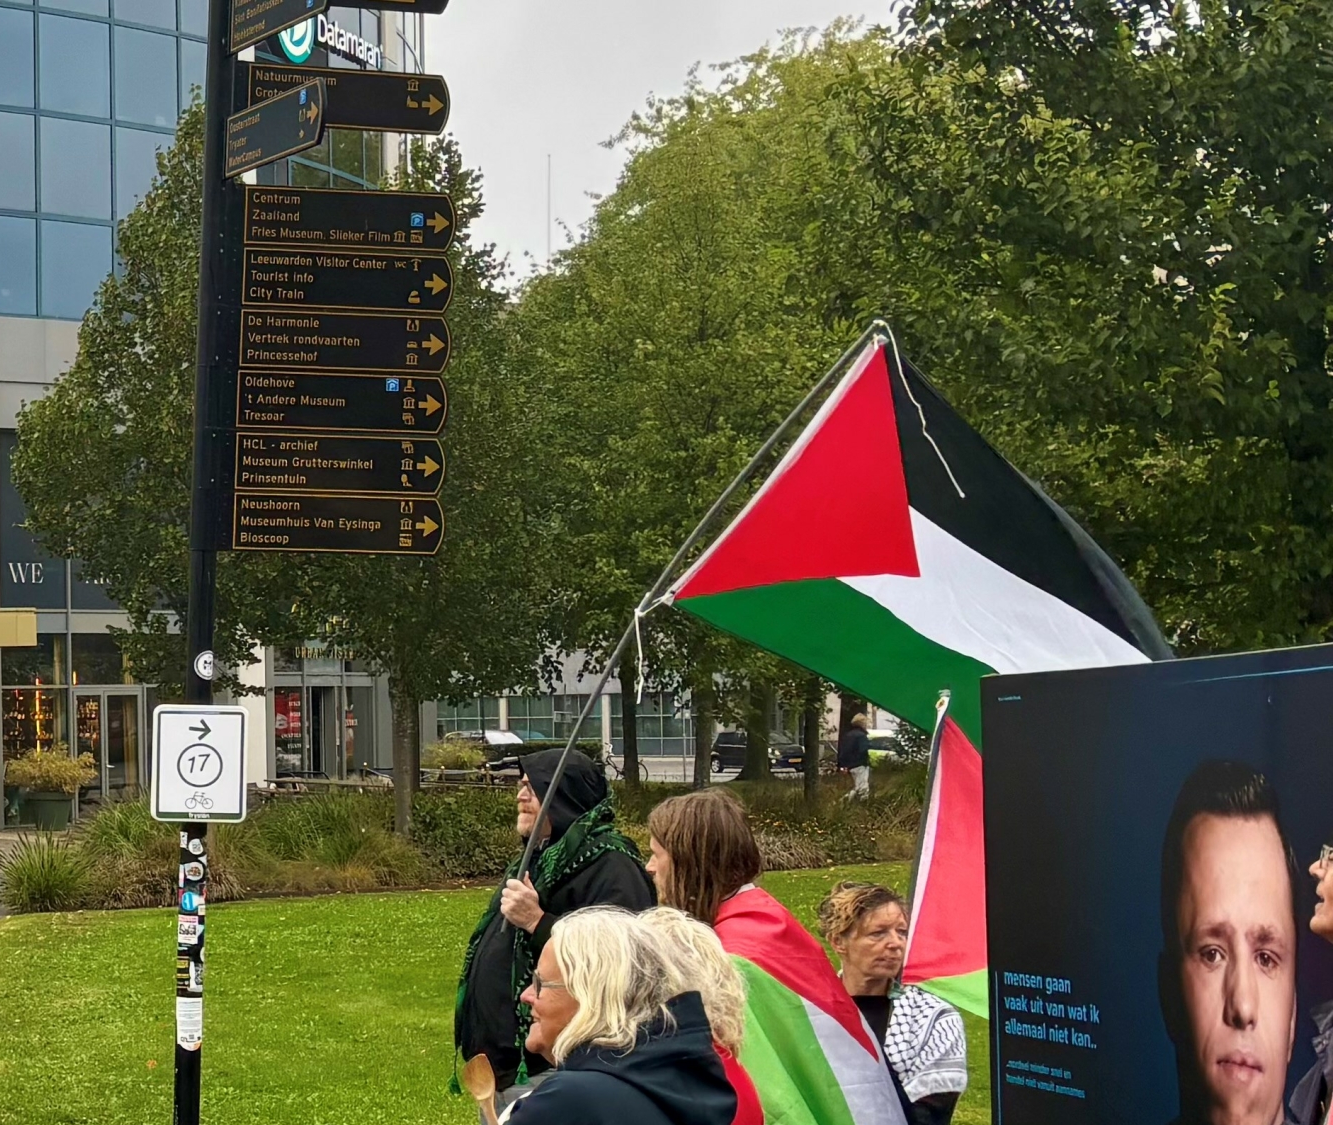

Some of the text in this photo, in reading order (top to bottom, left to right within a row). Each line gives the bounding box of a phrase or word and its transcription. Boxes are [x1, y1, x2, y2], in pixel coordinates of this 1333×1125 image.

[318, 14, 380, 69] Datamaran
[256, 70, 337, 86] Natuurmusm
[230, 113, 260, 134] Oosterstraat
[253, 193, 300, 204] Centrum
[252, 227, 276, 238] Fries
[330, 230, 365, 242] Slieker
[369, 232, 390, 243] Film
[251, 254, 312, 266] Leeuwarden
[316, 257, 350, 268] Visitor
[353, 258, 386, 269] Center
[251, 271, 288, 282] Tourist
[250, 287, 303, 299] City Train
[248, 315, 319, 328] De Harmonie
[248, 333, 360, 347] Vertrek rondvaarten
[247, 350, 317, 361] Princessehof
[245, 377, 295, 388] Oldehove
[256, 395, 296, 405] Andere
[301, 396, 345, 407] Museum
[245, 410, 285, 421] Tresoar
[243, 439, 266, 450] HCL
[280, 440, 318, 451] archief
[243, 456, 373, 470] Museum Grutterswinkel
[242, 473, 306, 484] Prinsentuin
[241, 499, 300, 511] Neushoorn
[241, 516, 381, 531] Museumhuis Van Eysinga
[241, 533, 289, 544] Bioscoop
[8, 562, 44, 584] WE
[188, 753, 210, 774] 17
[1004, 971, 1071, 995] mensen gaan
[1004, 995, 1100, 1024] vaak uit van wat ik
[1005, 1019, 1046, 1040] allemaal
[1050, 1025, 1068, 1044] niet
